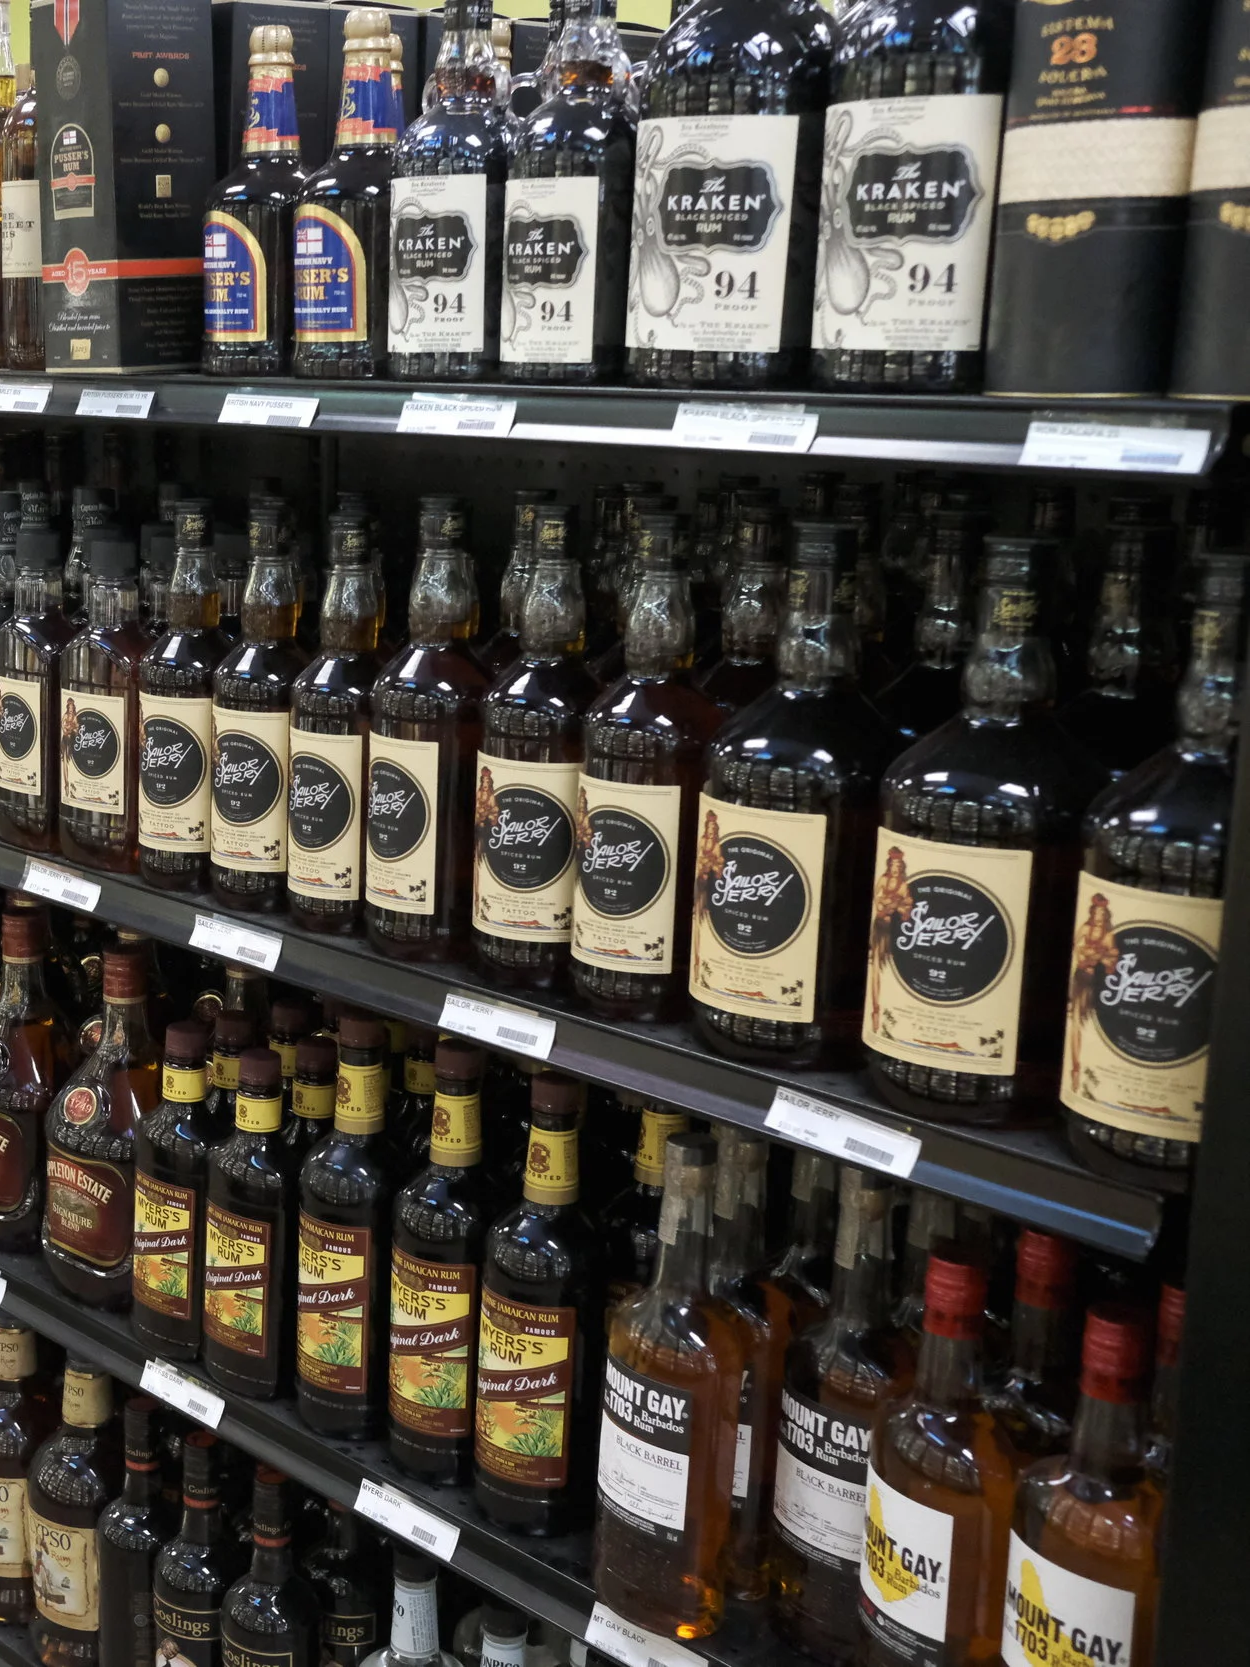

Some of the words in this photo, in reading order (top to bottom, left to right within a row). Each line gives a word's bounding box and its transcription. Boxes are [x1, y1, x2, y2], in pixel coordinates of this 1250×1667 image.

[54, 151, 89, 163] PUSSER'S
[893, 162, 922, 180] The
[701, 176, 726, 192] The
[856, 181, 961, 200] KRAKEN
[667, 195, 761, 211] KRAKEN
[904, 202, 946, 211] SPICED
[675, 213, 708, 222] BLACK
[710, 213, 748, 222] SPICED
[887, 212, 916, 223] RUM
[417, 224, 434, 237] The
[527, 228, 544, 241] The
[696, 222, 722, 233] RUM
[399, 238, 462, 251] KRAKEN
[509, 242, 572, 256] KRAKEN
[68, 261, 86, 283] 15
[908, 263, 958, 294] 94
[714, 270, 760, 299] 94
[433, 293, 465, 314] 94
[541, 300, 574, 322] 94
[714, 303, 757, 311] PROOF
[227, 399, 249, 407] BRITISH
[250, 400, 264, 408] NAVY
[265, 401, 293, 409] PUSSERS
[405, 404, 432, 412] KRAKEN
[434, 405, 458, 413] BLACK
[156, 726, 178, 735] ORIGINAL
[230, 741, 254, 751] ORIGINAL
[514, 797, 544, 807] ORIGINAL
[222, 839, 249, 848] TATTOO
[582, 842, 654, 873] JERRY
[31, 863, 48, 873] SAILOR
[294, 864, 320, 874] TATTOO
[513, 863, 526, 871] 92
[604, 888, 617, 897] 92
[500, 909, 537, 917] TATTOO
[724, 908, 749, 916] SPICED
[737, 923, 752, 933] 92
[592, 934, 627, 945] TATTOO
[928, 968, 947, 979] 92
[1106, 953, 1195, 992] SAILOR
[446, 998, 471, 1010] SAILOR
[472, 1005, 494, 1016] JERRY
[911, 1023, 957, 1037] TATTOO
[1135, 1026, 1156, 1038] 92
[68, 1098, 92, 1112] 1749
[778, 1092, 810, 1110] SAILOR
[811, 1104, 840, 1122] JERRY
[76, 1170, 113, 1203] ESTATE
[150, 1182, 177, 1198] JAMAICAN
[138, 1196, 180, 1223] MYERS'S
[167, 1199, 186, 1209] FAMOUS
[52, 1202, 93, 1229] SIGNATURE
[61, 1216, 80, 1232] BLEND
[145, 1213, 167, 1230] RUM
[223, 1216, 249, 1233] JAMAICAN
[134, 1237, 159, 1252] Original
[160, 1236, 187, 1247] Dark
[209, 1231, 255, 1258] MYERS'S
[326, 1244, 351, 1254] FAMOUS
[217, 1246, 241, 1265] RUM
[402, 1259, 439, 1278] JAMAICAN
[206, 1271, 233, 1287] Original
[234, 1271, 263, 1283] Dark
[318, 1288, 355, 1304] Dark
[392, 1281, 447, 1312] MYERS'S
[428, 1283, 457, 1293] FAMOUS
[398, 1298, 427, 1321] RUM
[496, 1303, 536, 1321] JAMAICAN
[420, 1327, 459, 1346] Dark
[482, 1321, 545, 1354] MYERS'S
[525, 1326, 556, 1336] FAMOUS
[515, 1373, 558, 1391] Dark
[606, 1369, 645, 1407] MOUNT
[648, 1391, 686, 1421] GAY
[609, 1394, 633, 1423] 1703
[633, 1416, 654, 1434] Rum
[641, 1410, 684, 1434] Barbados
[781, 1389, 828, 1437] MOUNT
[831, 1423, 871, 1452] GAY
[786, 1423, 814, 1453] 1703
[616, 1435, 643, 1458] BLACK
[644, 1451, 683, 1471] BARREL
[816, 1447, 839, 1466] Rum
[795, 1466, 826, 1489] BLACK
[362, 1483, 383, 1498] MYERS
[384, 1495, 402, 1508] DARK
[50, 1552, 71, 1566] Rum
[901, 1546, 942, 1584] GAY
[886, 1574, 908, 1596] Rum
[893, 1569, 941, 1599] Barbados
[593, 1614, 603, 1623] MT
[604, 1619, 622, 1633] GAY
[622, 1627, 648, 1645] BLACK
[1007, 1580, 1065, 1643] MOUNT
[1072, 1628, 1123, 1665] GAY
[1015, 1619, 1048, 1661] 1703
